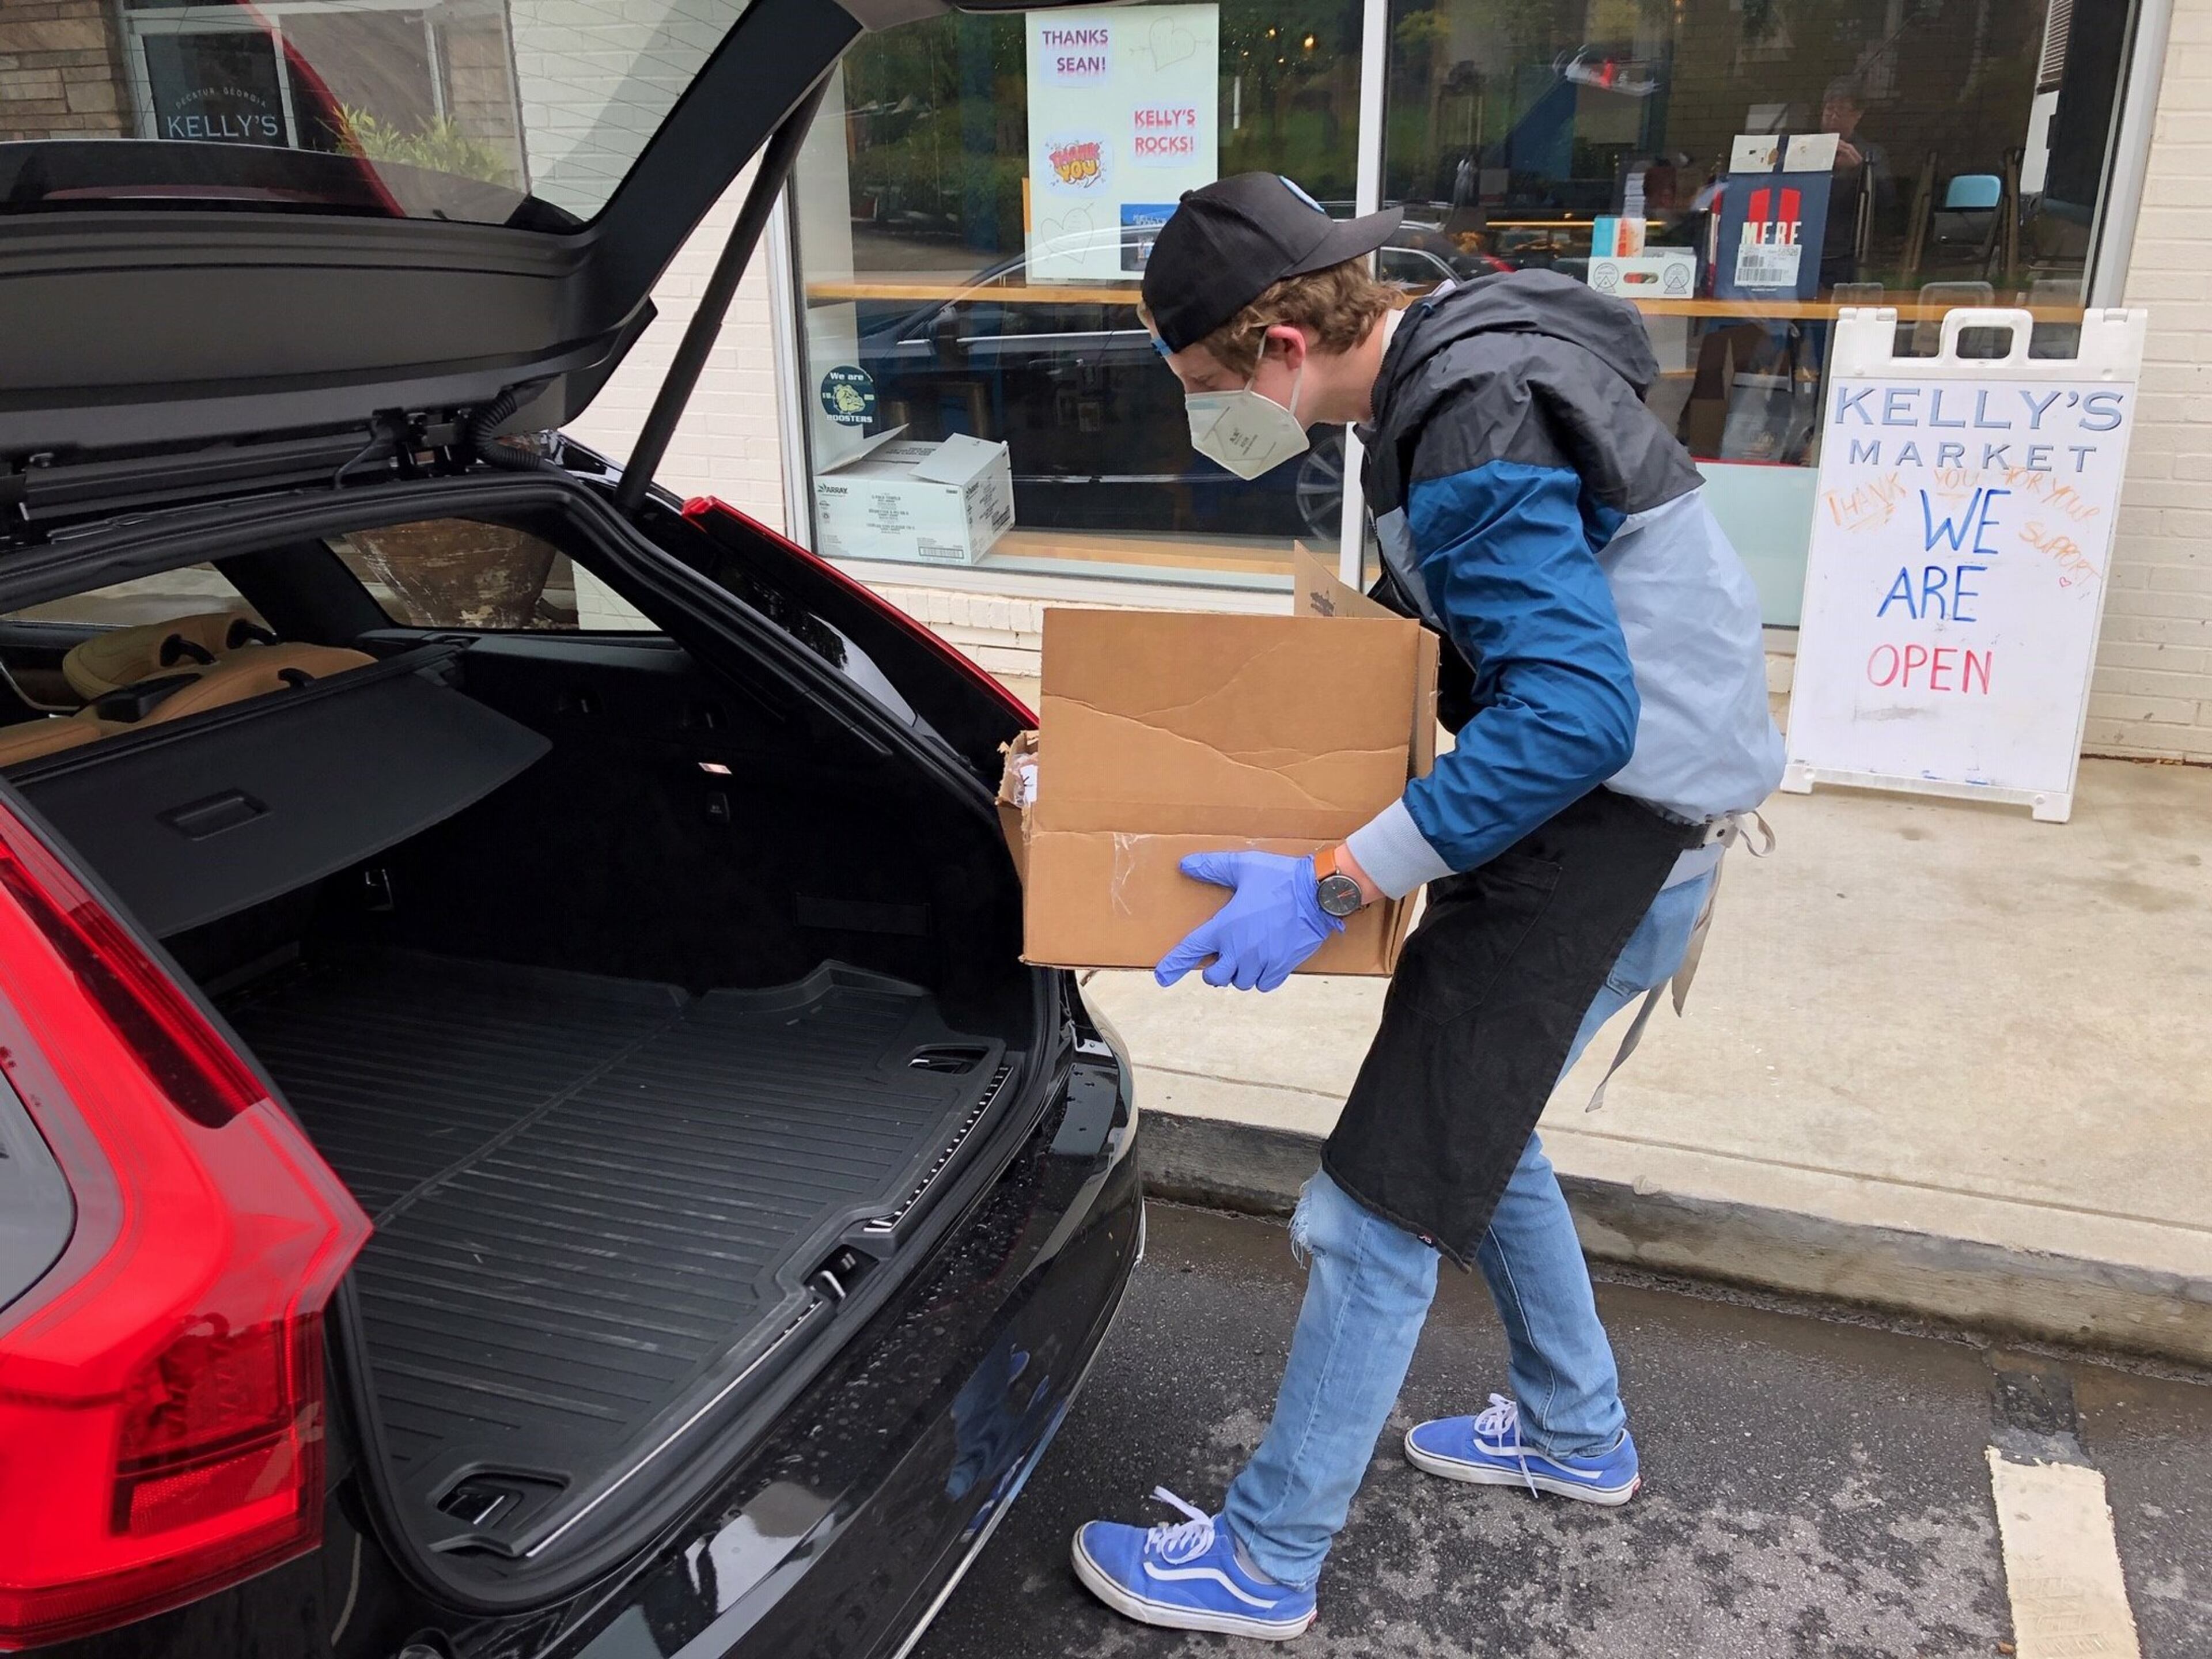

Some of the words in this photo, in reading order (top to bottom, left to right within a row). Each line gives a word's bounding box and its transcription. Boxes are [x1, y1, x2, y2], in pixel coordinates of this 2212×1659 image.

[1042, 29, 1108, 45] THANKS
[1056, 56, 1105, 71] SEAN!
[224, 87, 266, 108] GEORGIA
[167, 115, 278, 138] KELLY'S
[1134, 109, 1195, 126] KELLY'S
[1135, 137, 1194, 153] ROCKS!
[1058, 160, 1097, 181] YOU
[827, 415, 873, 423] BOOSTERS
[1835, 386, 2124, 431] KELLY'S
[1849, 439, 2097, 473] MARKET
[1822, 471, 1907, 526] THANK
[1933, 468, 1980, 489] YOU
[2001, 466, 2044, 494] FOR
[1919, 487, 2012, 554] WE
[2018, 521, 2103, 586] SUPPORT
[1877, 565, 1987, 622] ARE
[1868, 643, 1993, 695] OPEN
